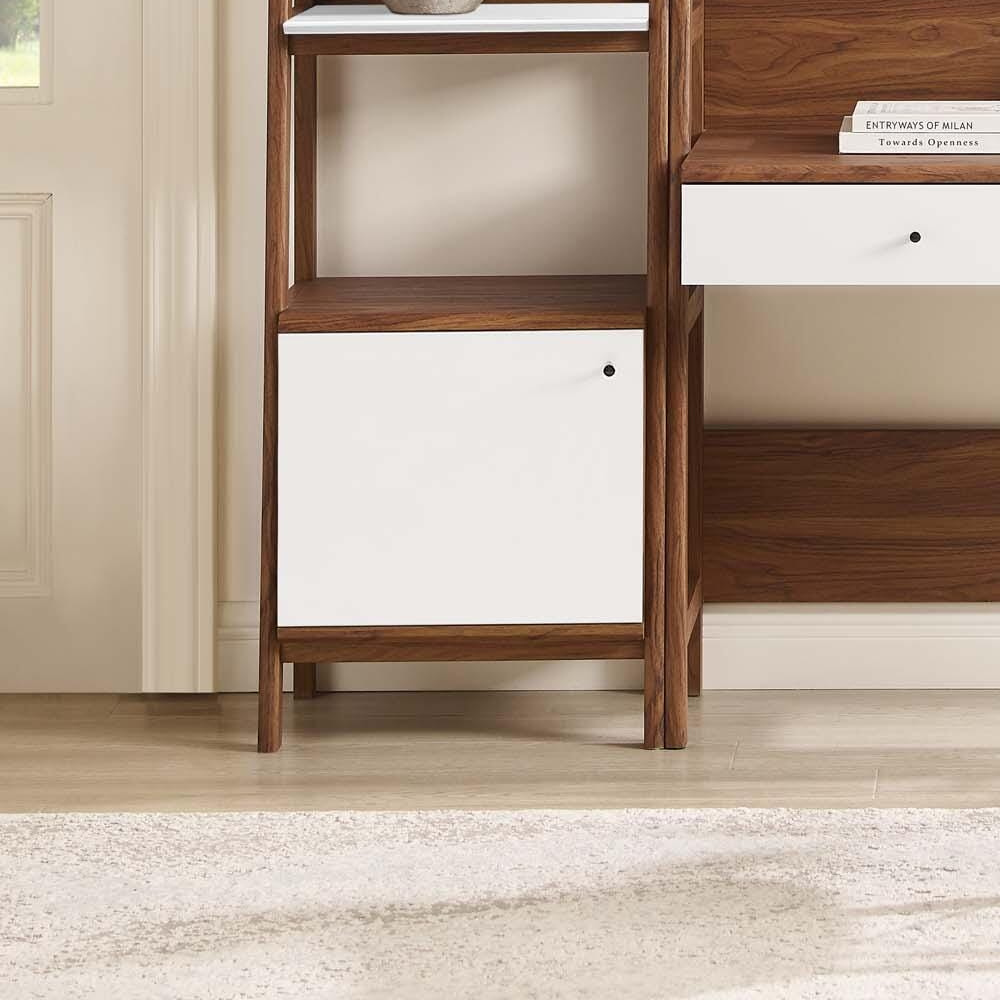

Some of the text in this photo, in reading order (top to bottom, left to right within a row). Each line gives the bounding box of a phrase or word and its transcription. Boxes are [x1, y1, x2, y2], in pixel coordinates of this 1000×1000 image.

[866, 121, 973, 130] ENTRYWAYS OF MILAN
[879, 138, 979, 148] Towards Openness
